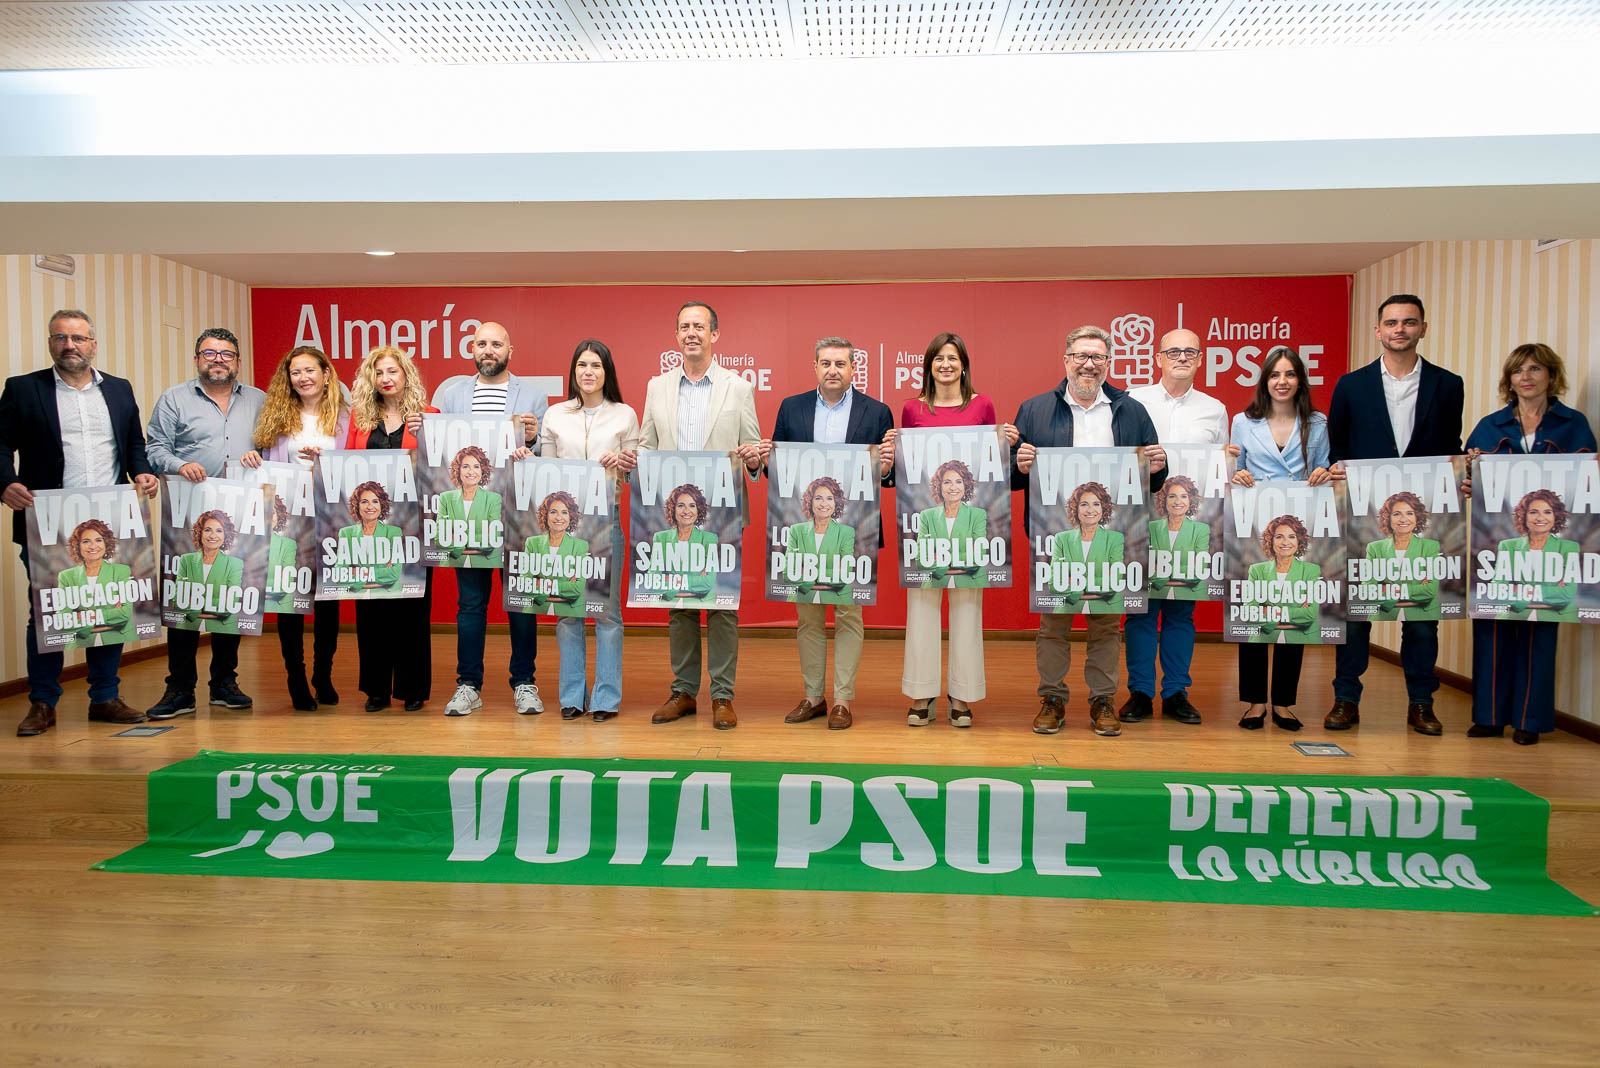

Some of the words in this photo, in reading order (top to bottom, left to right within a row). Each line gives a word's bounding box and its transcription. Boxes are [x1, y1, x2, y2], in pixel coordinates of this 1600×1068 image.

[294, 303, 483, 360] Almería
[1207, 316, 1291, 341] Almería
[896, 350, 924, 365] Alme
[1206, 345, 1324, 387] PSE
[729, 369, 772, 391] OE
[895, 367, 924, 391] PS
[423, 419, 516, 468] VOTA
[901, 431, 1004, 484] VOTA
[319, 454, 418, 503] VOTA
[514, 461, 608, 516] VOTA
[637, 455, 736, 507] VOTA
[775, 448, 874, 501] VOTA
[1036, 453, 1143, 505] VOTA
[1345, 462, 1460, 516] VOTA
[1480, 460, 1600, 514] VOTA
[34, 490, 146, 545] VOTA
[167, 481, 265, 536] VOTA
[423, 494, 440, 514] LO
[1231, 487, 1340, 538] VOTA
[424, 515, 504, 548] PÚBLIC
[772, 526, 790, 547] LO
[902, 512, 920, 534] LO
[322, 536, 420, 565] SANIDAD
[635, 541, 736, 573] SANIDAD
[903, 534, 1006, 567] PÚBLICO
[1035, 535, 1055, 556] LO
[164, 554, 180, 575] LO
[322, 566, 376, 583] PÚBLICA
[509, 551, 606, 580] EDUCACIÓN
[771, 549, 872, 584] PÚBLICO
[988, 574, 1006, 582] PSOE
[1035, 557, 1143, 592] PÚBLICO
[1348, 553, 1461, 582] EDUCACIÓN
[1476, 550, 1600, 583] SANIDAD
[40, 576, 153, 613] EDUCACIÓN
[508, 574, 559, 595] PÚBLICA
[635, 572, 689, 590] PÚBLICA
[1230, 577, 1340, 604] EDUCACIÓN
[1348, 581, 1410, 601] PÚBLICA
[1476, 582, 1543, 602] PÚBLICA
[163, 577, 260, 616] PÚBLICO
[293, 601, 310, 609] PSOE
[586, 604, 604, 612] PSOE
[853, 592, 871, 600] PSOE
[1124, 600, 1142, 608] PSOE
[1441, 606, 1461, 614] PSOE
[42, 608, 105, 631] PÚBLICA
[238, 622, 256, 630] PSOE
[1230, 603, 1290, 622] PÚBLICA
[136, 626, 156, 635] PSOE
[1321, 630, 1340, 638] PSOE
[235, 763, 395, 771] Andalucía
[217, 770, 383, 823] PSOE
[447, 767, 738, 867] VOTA
[775, 773, 1102, 877] PSOE
[1163, 783, 1477, 840] DEFIENDE
[1168, 845, 1238, 881] LO
[1245, 840, 1491, 890] PÚBLICO
